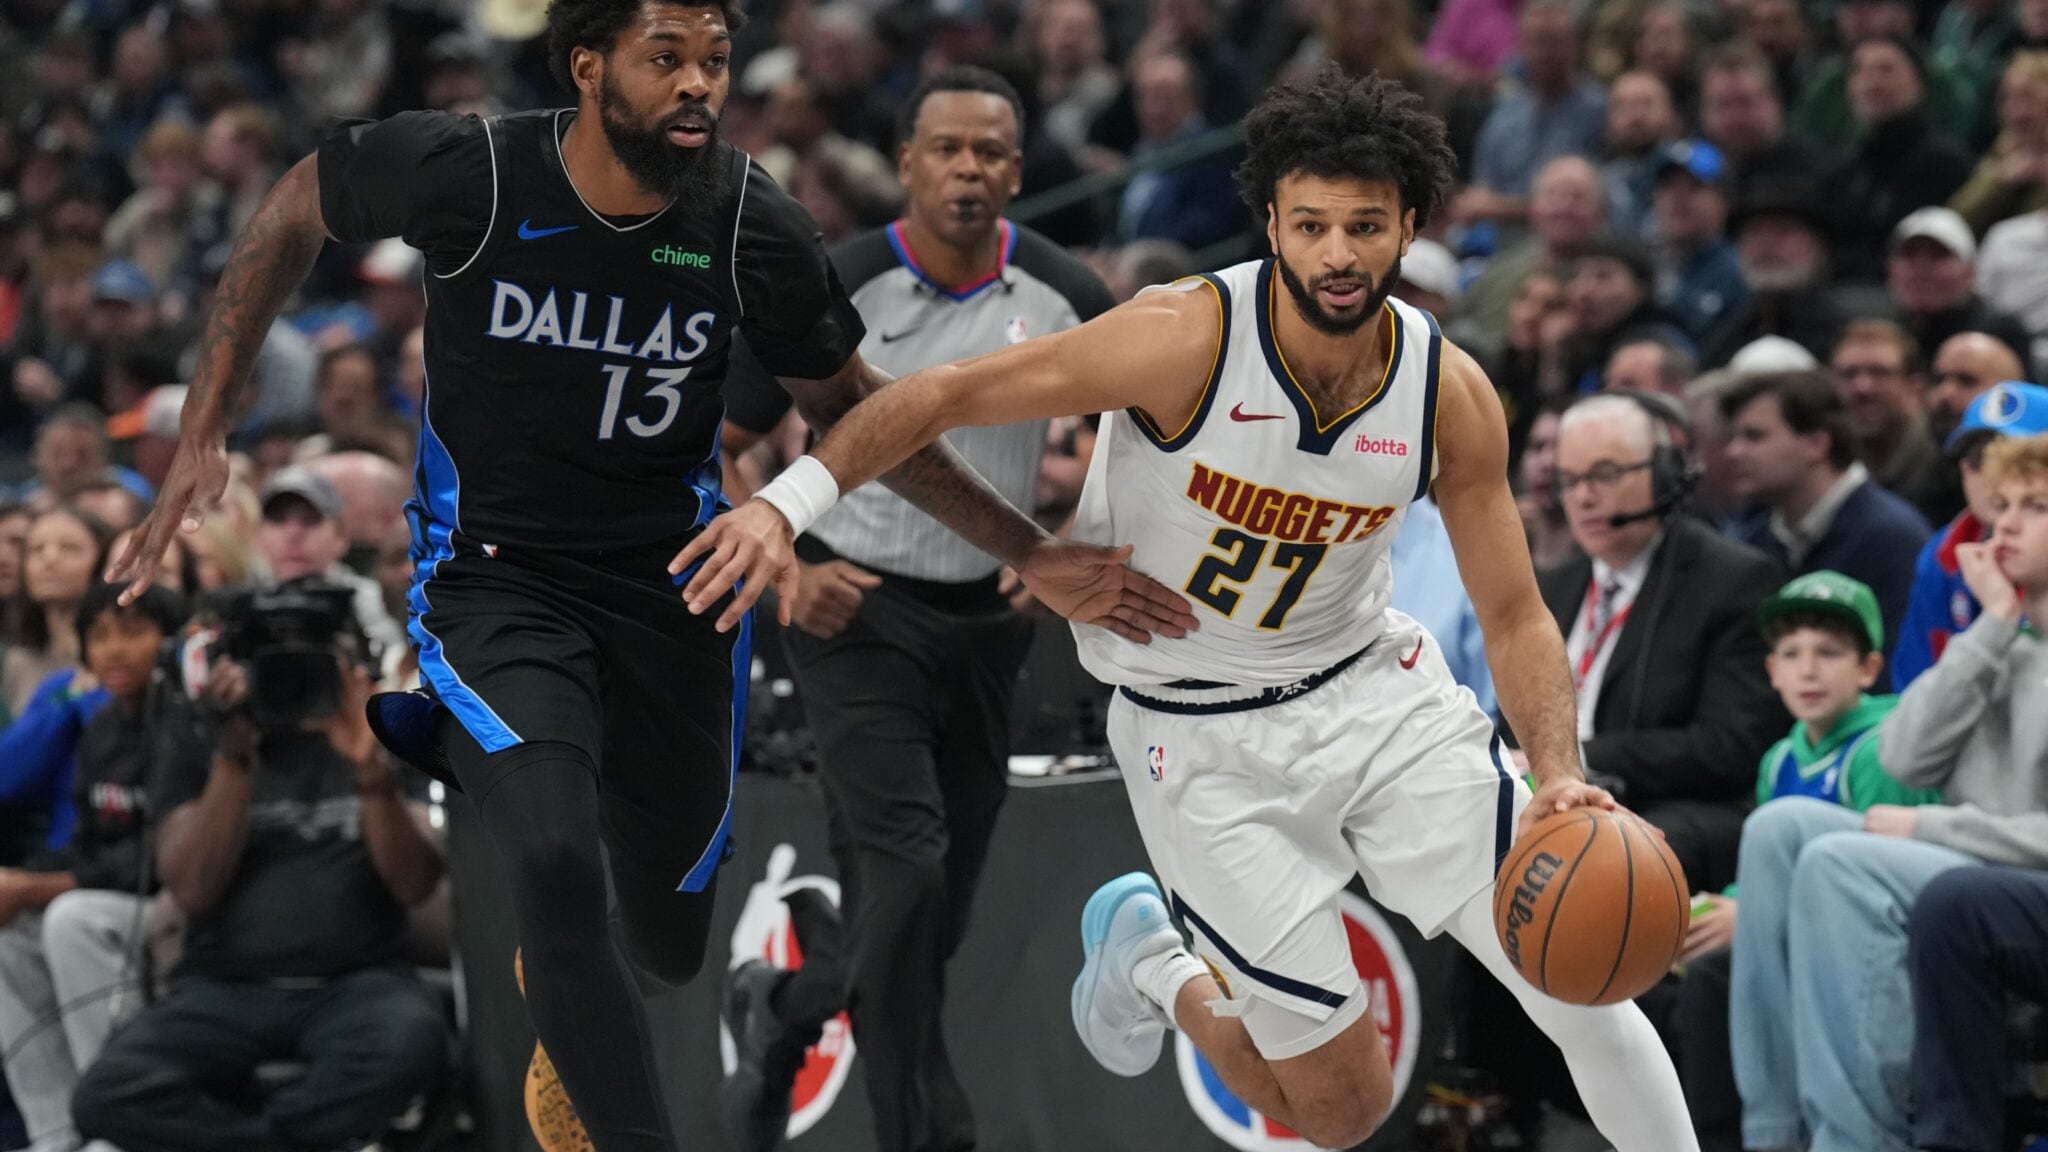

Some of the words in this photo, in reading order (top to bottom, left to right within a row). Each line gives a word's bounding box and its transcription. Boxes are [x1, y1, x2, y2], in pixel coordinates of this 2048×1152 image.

[651, 245, 712, 269] chime
[485, 278, 716, 362] DALLAS
[598, 363, 693, 440] 13
[1354, 435, 1408, 457] ibotta
[1186, 461, 1397, 544] NUGGETS
[1183, 526, 1332, 632] 27
[1505, 851, 1564, 970] Wilson
